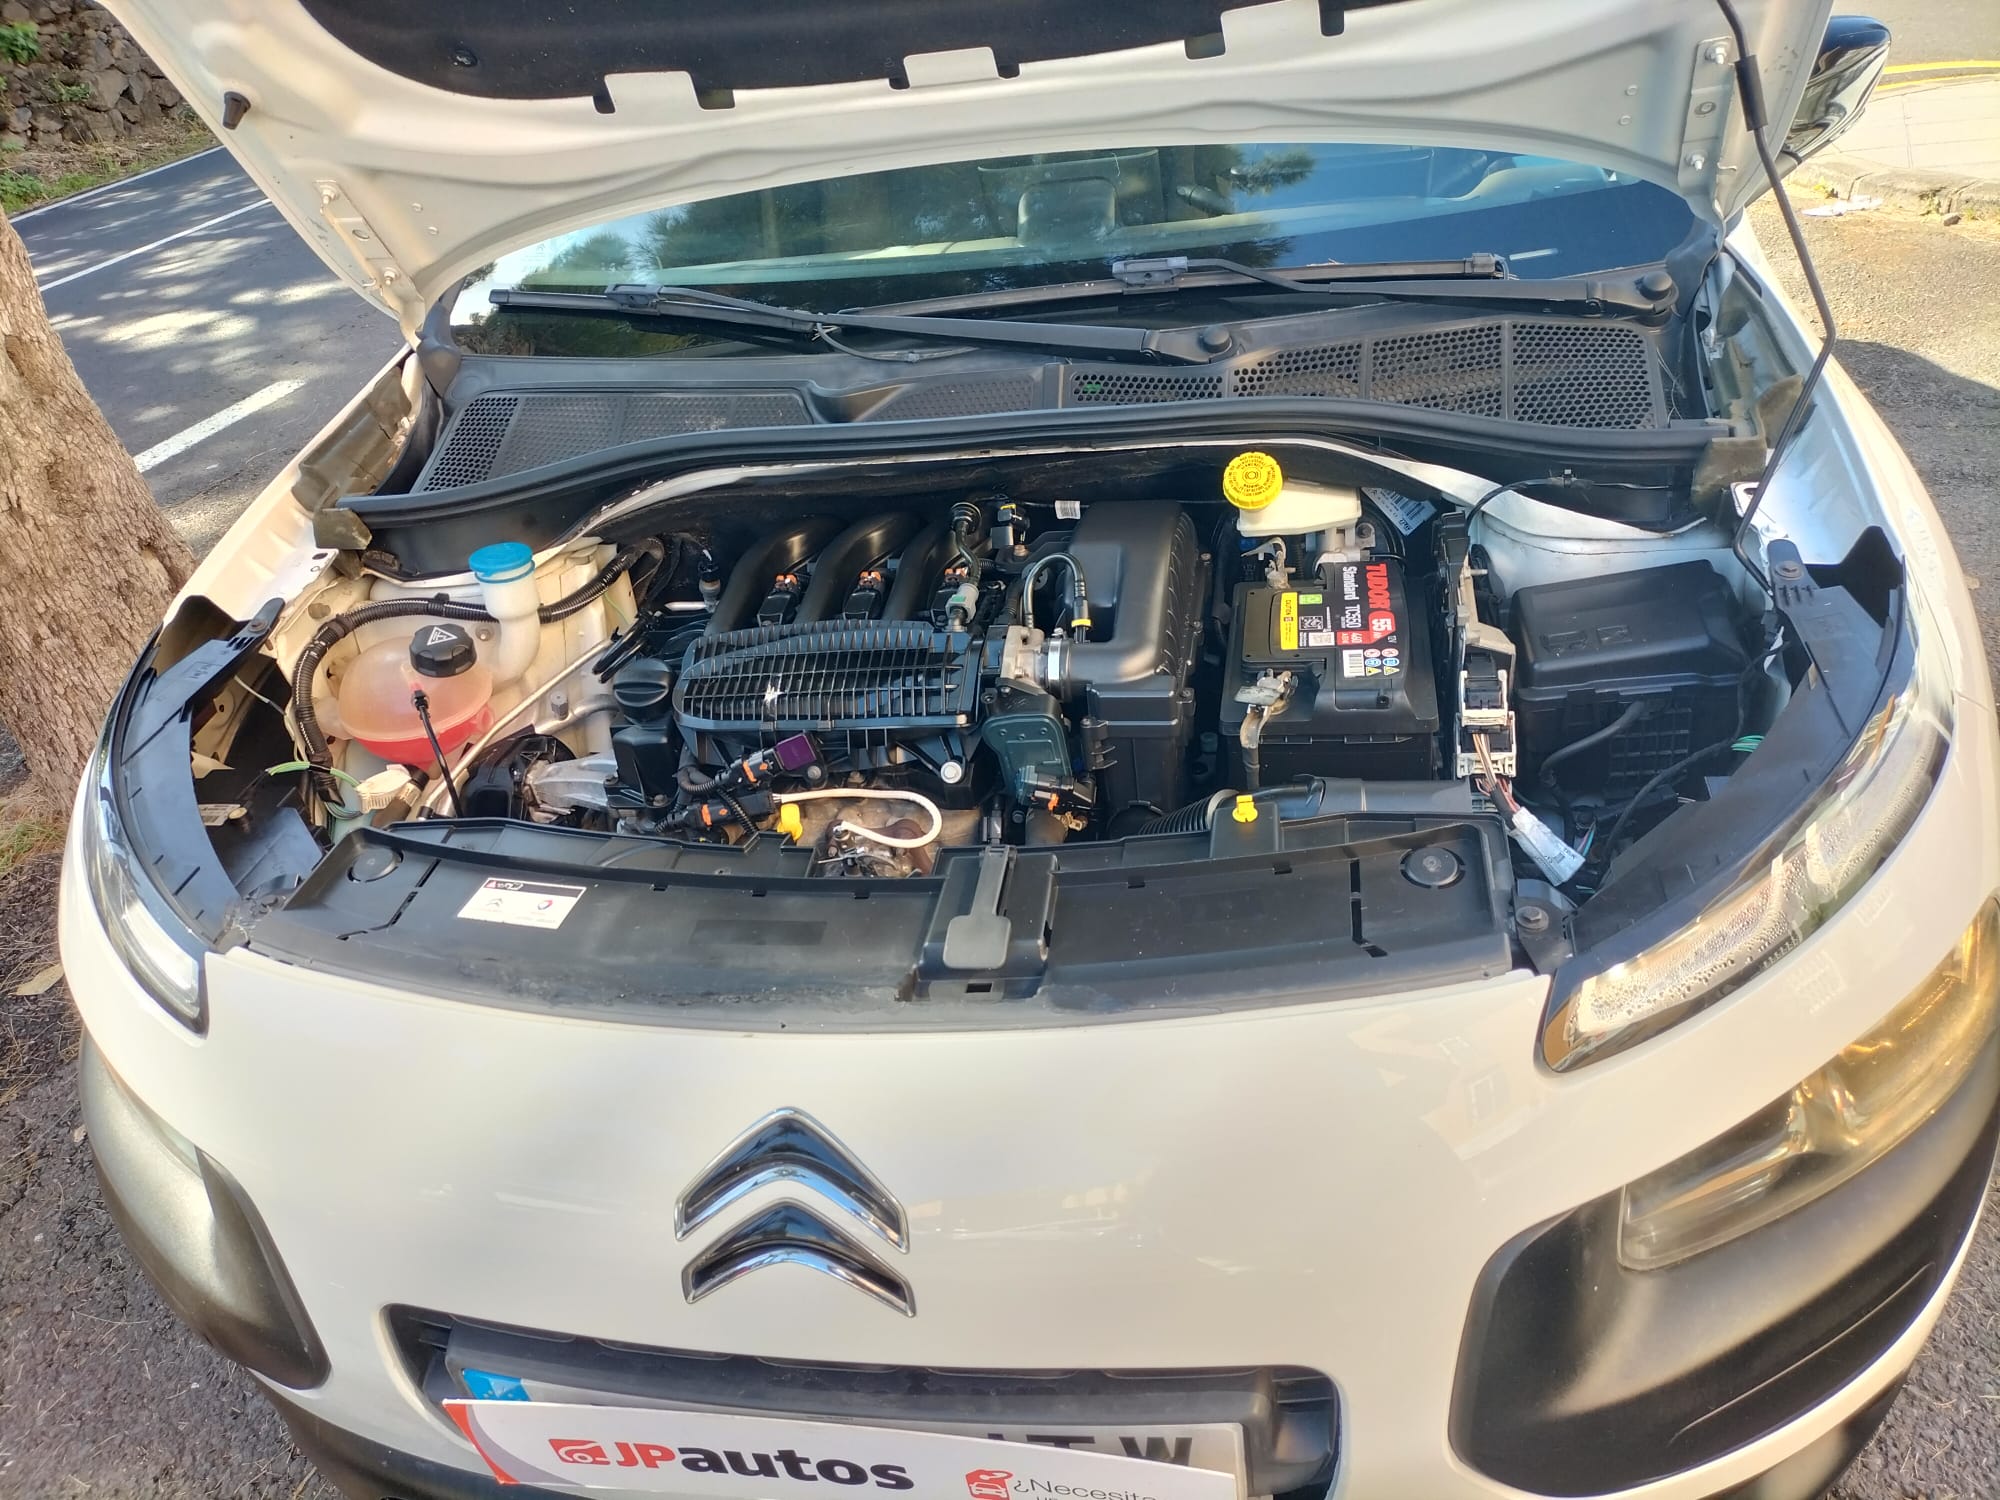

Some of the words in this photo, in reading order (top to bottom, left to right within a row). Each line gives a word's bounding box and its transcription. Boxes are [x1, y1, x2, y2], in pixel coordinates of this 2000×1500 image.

[1342, 566, 1360, 600] Standard
[1366, 563, 1391, 609] TUDOR
[1344, 604, 1362, 628] TC550
[1371, 618, 1393, 631] 55
